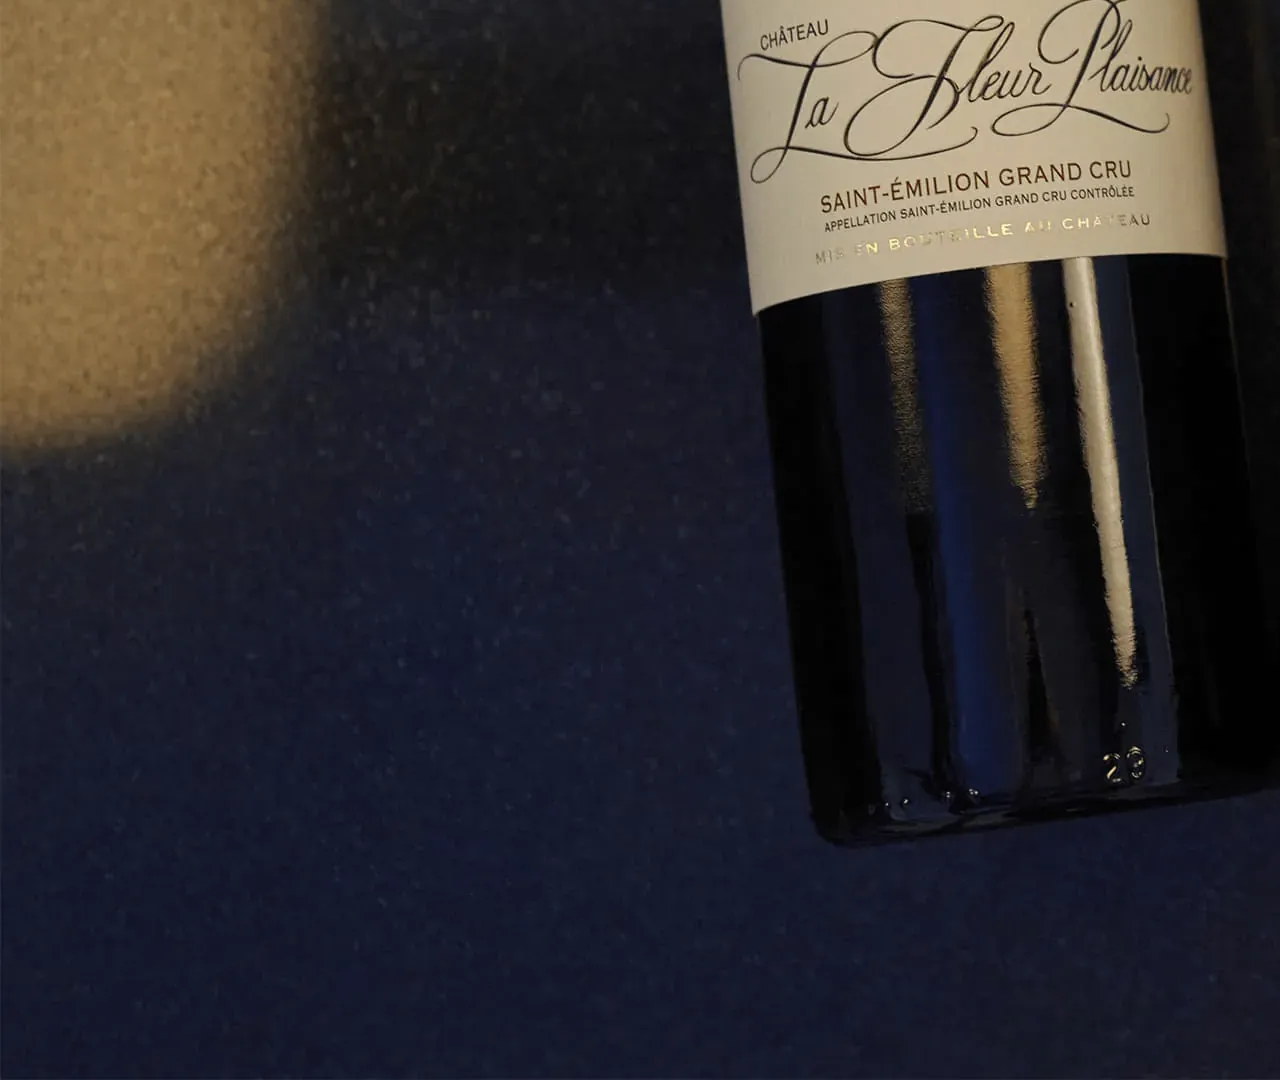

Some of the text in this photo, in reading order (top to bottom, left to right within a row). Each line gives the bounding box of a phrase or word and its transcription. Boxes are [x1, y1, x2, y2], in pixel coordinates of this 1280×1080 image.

[759, 18, 831, 52] CHÂTEAU
[820, 159, 1133, 214] SAINT-ÉMILION GRAND CRU
[824, 185, 1135, 233] APPELLATION SAINT-ÉMILION GRAND CRU CONTRÔLÉE
[854, 240, 879, 256] EN
[1024, 220, 1052, 234] AU
